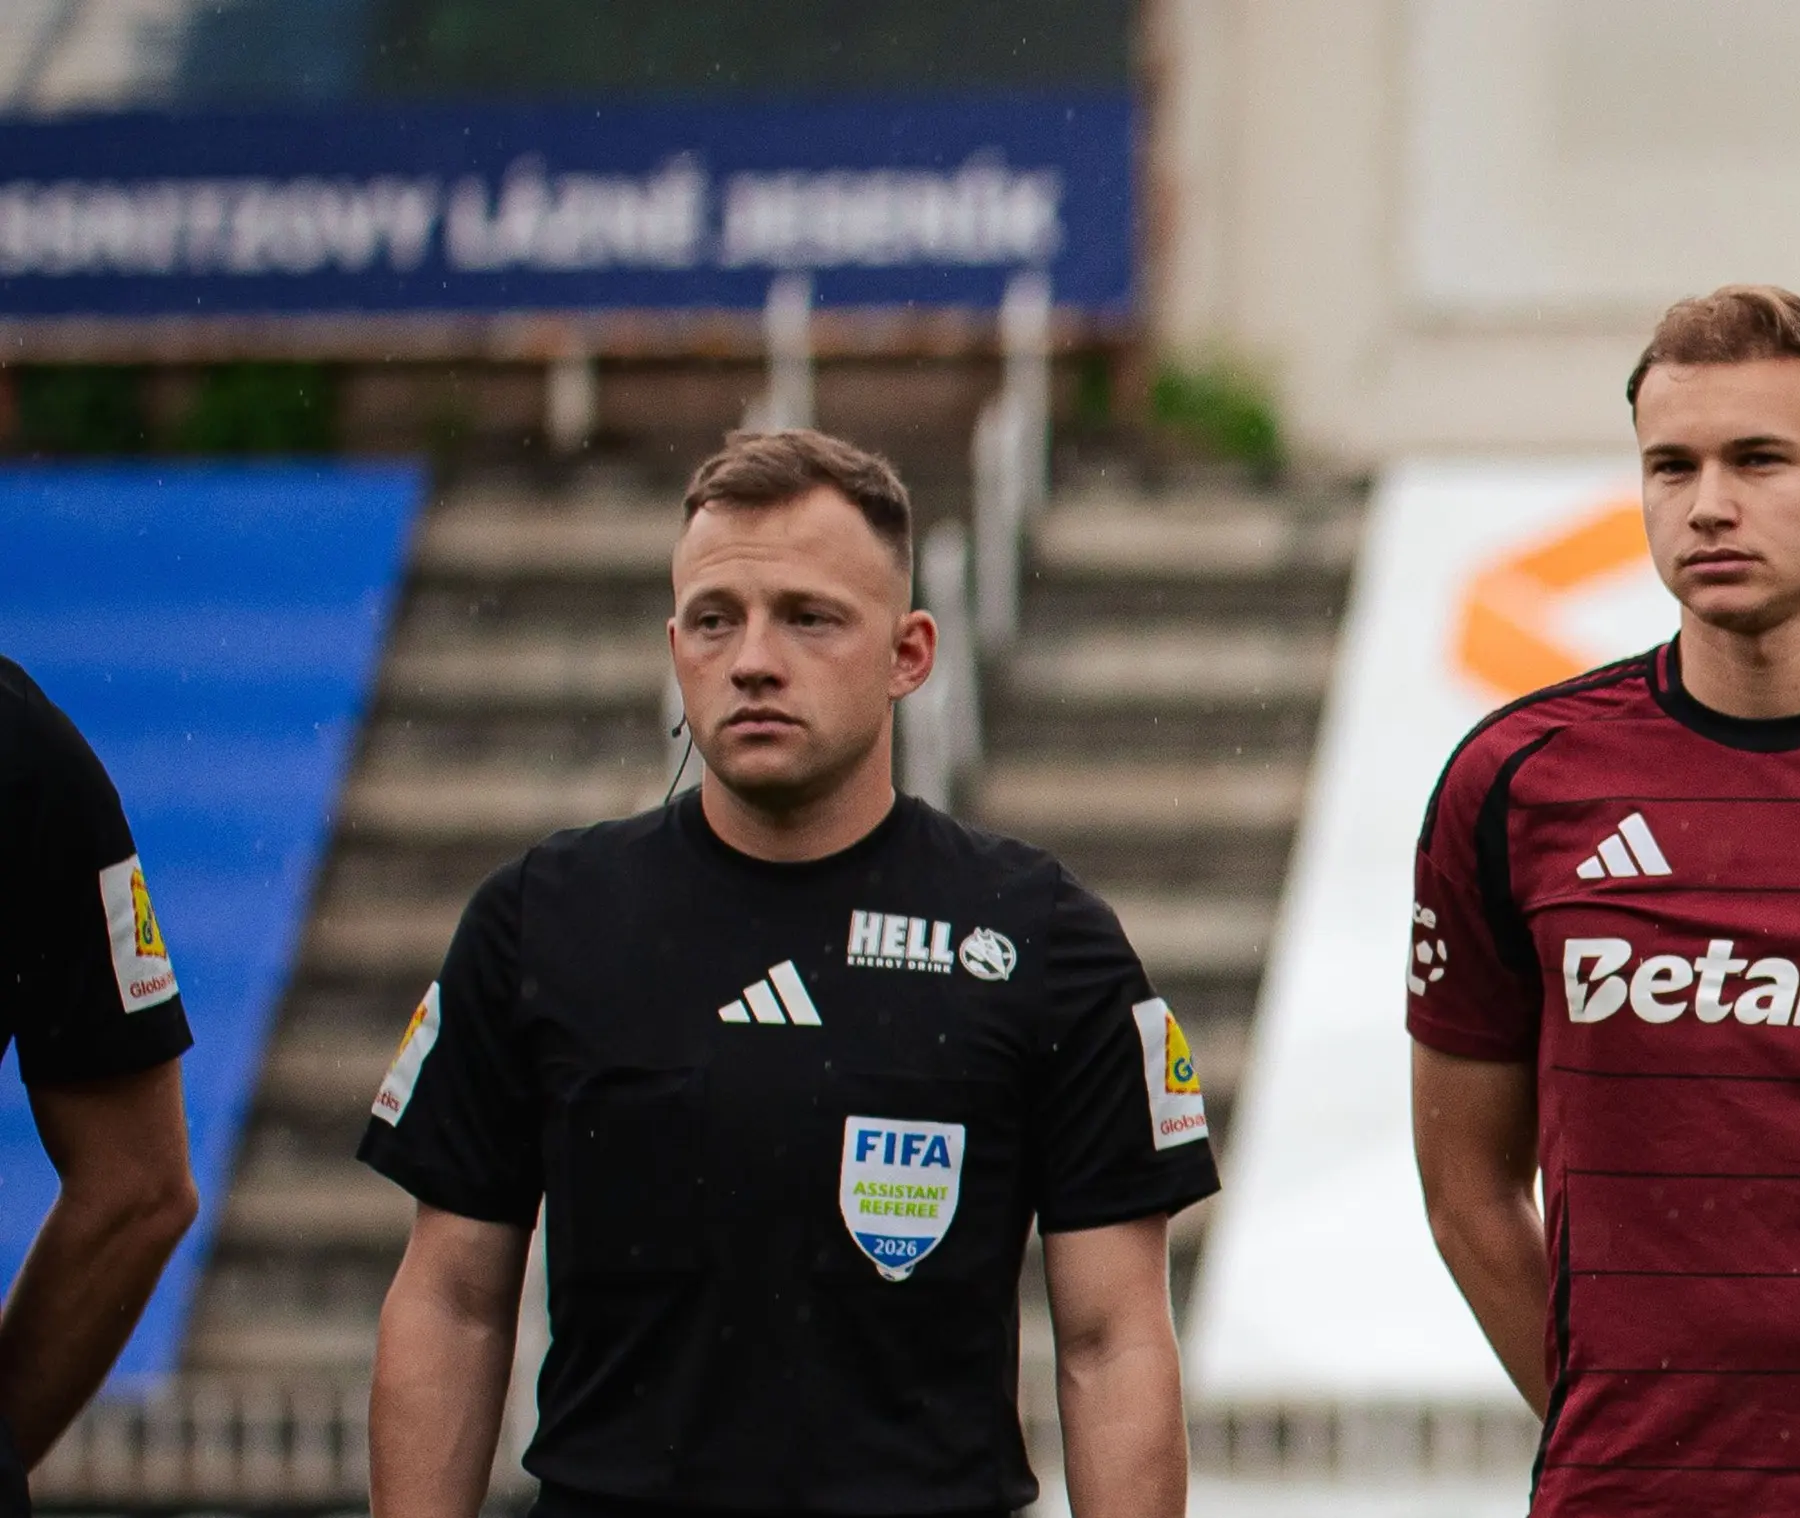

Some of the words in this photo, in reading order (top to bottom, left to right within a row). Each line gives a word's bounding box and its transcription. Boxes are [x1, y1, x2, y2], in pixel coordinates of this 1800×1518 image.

[848, 909, 954, 964] HELL
[847, 955, 902, 969] ENERGY
[907, 961, 952, 975] DRINK
[130, 970, 174, 999] Globa
[1160, 1113, 1206, 1136] Globa
[855, 1129, 952, 1169] FIFA
[853, 1180, 949, 1201] ASSISTANT
[859, 1198, 939, 1219] REFEREE
[873, 1237, 917, 1257] 2026
